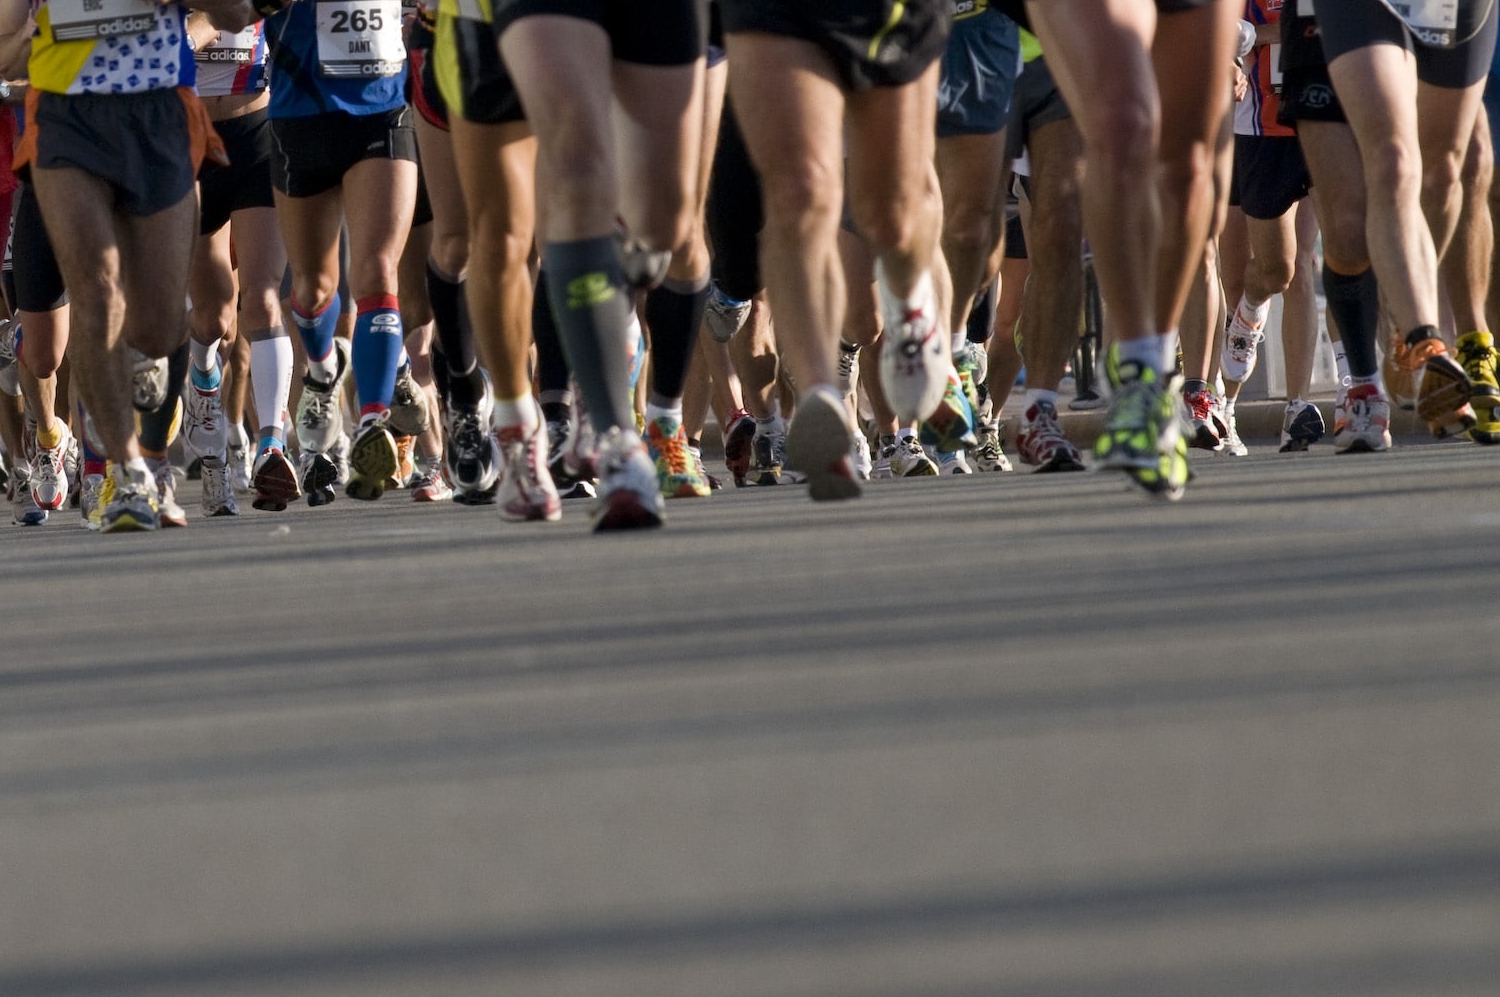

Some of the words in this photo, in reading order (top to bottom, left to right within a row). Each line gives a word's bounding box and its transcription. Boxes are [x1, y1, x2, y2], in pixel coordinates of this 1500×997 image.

[99, 17, 151, 36] adidas
[330, 8, 384, 33] 265
[209, 49, 250, 61] adidas
[362, 61, 403, 75] adidas
